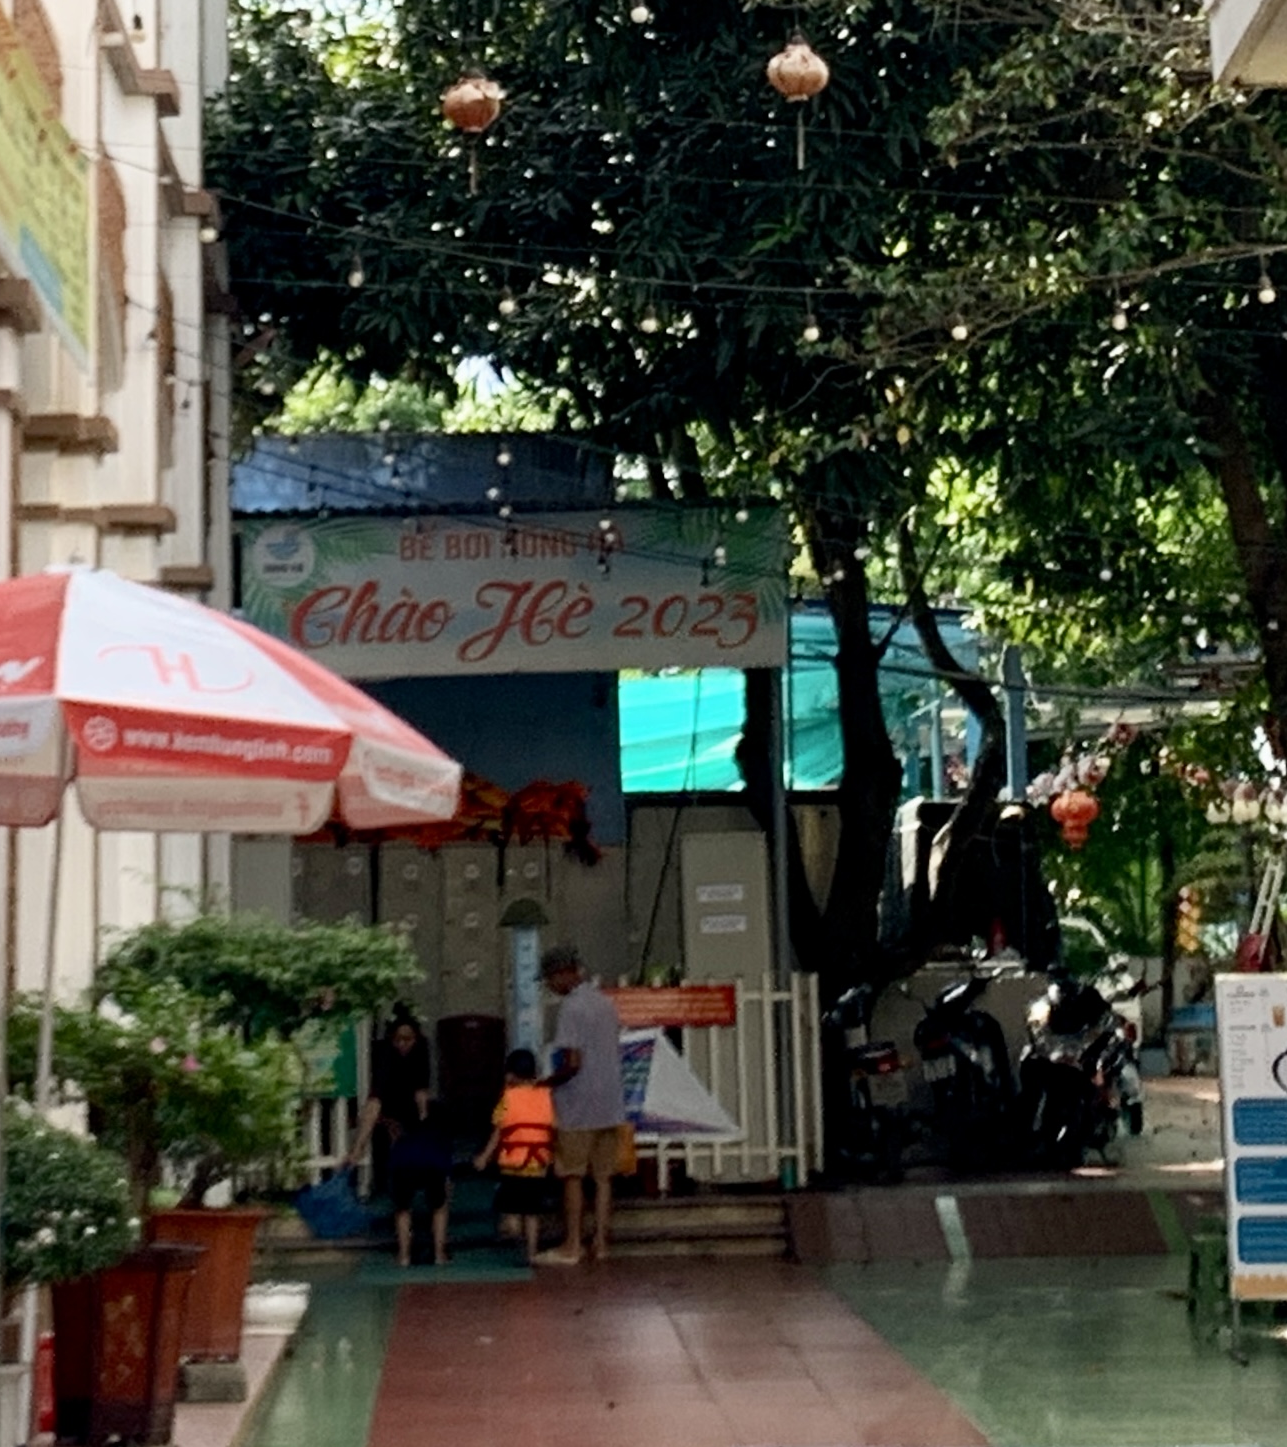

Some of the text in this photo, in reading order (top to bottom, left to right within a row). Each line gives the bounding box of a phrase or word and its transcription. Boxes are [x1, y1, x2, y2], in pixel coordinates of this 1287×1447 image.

[290, 580, 760, 664] Chào Hè 2023
